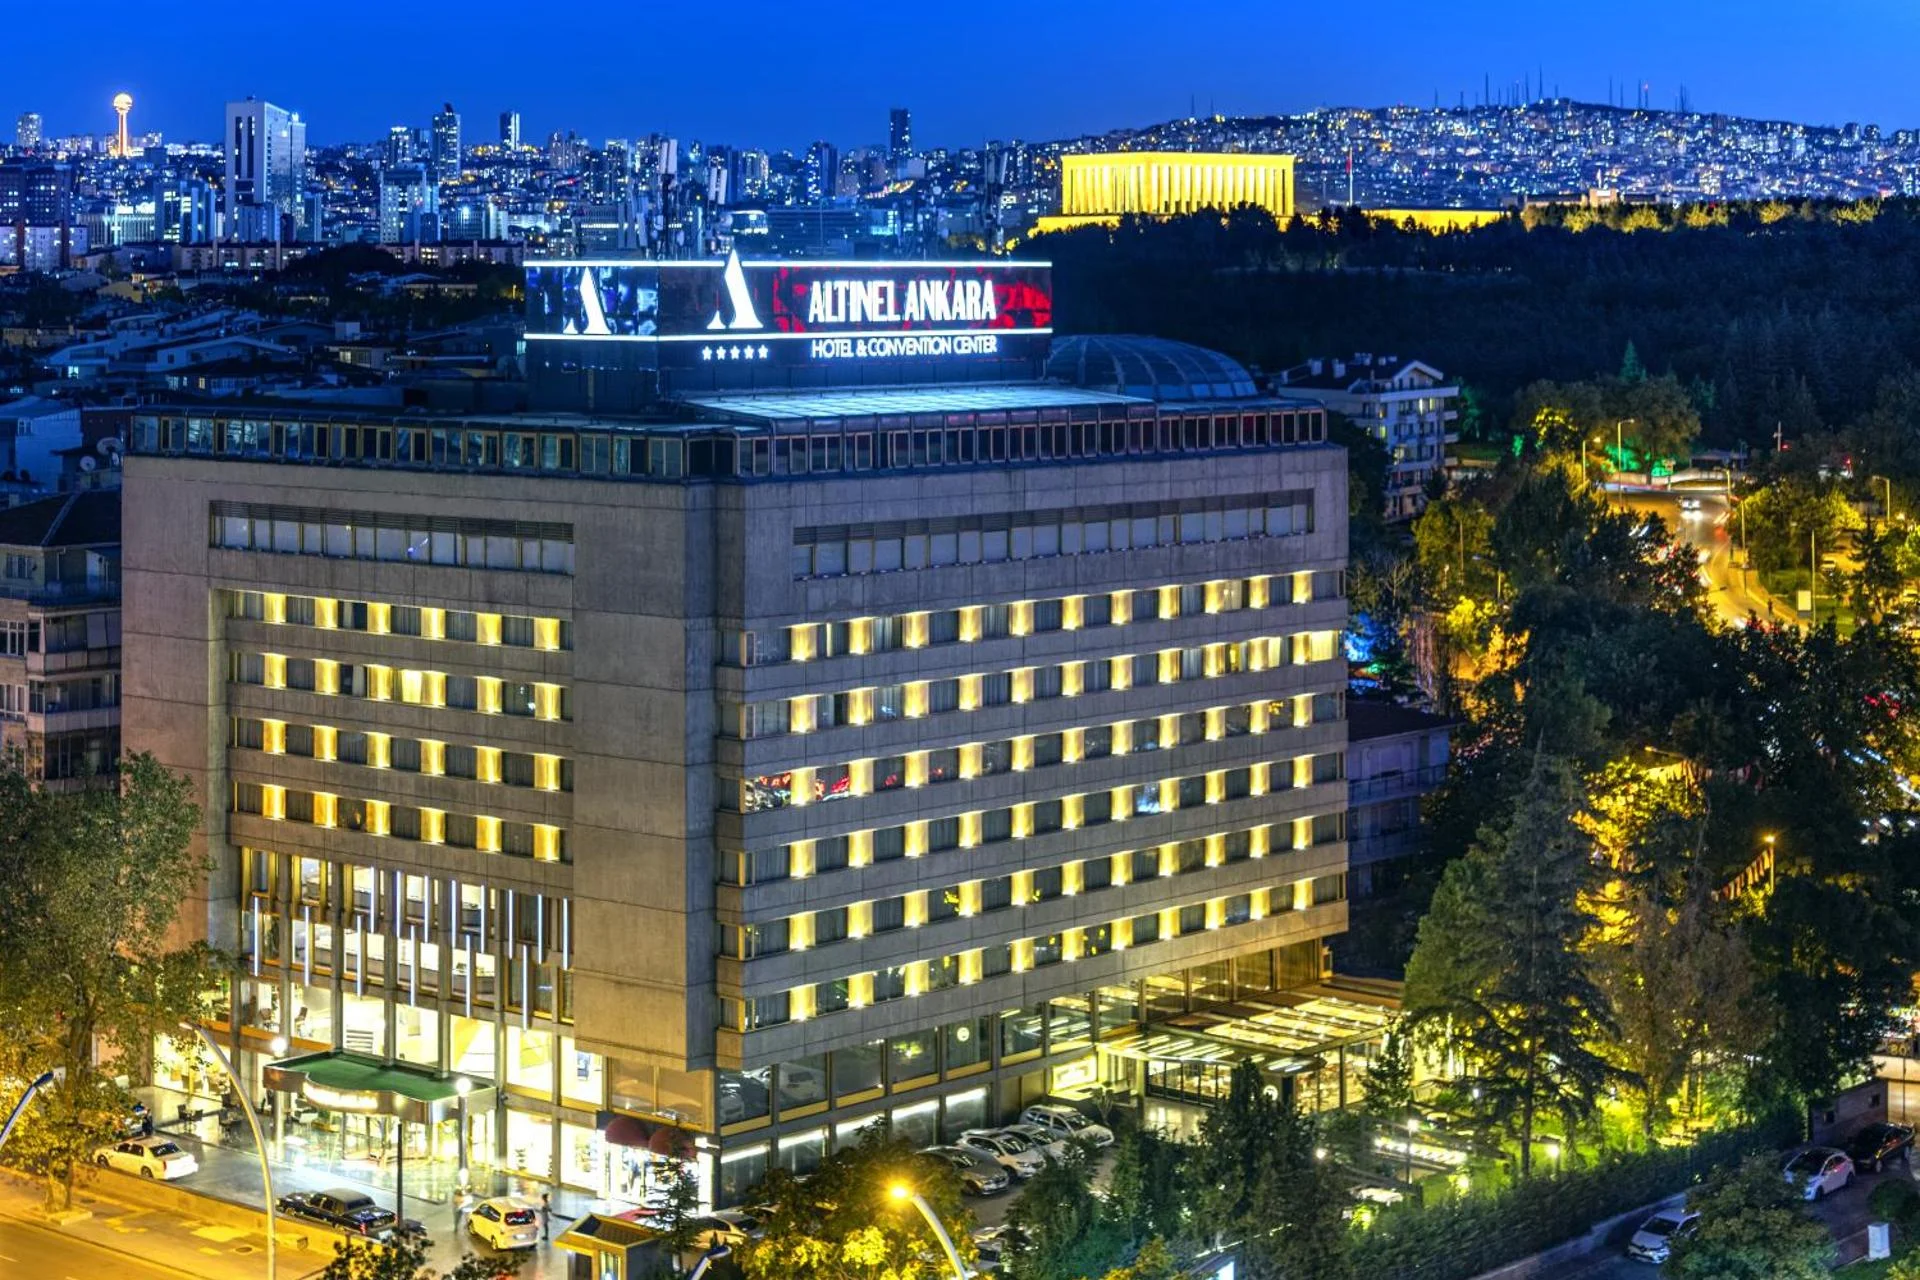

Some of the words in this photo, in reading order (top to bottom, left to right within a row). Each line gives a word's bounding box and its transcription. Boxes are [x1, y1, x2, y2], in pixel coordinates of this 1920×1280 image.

[808, 280, 901, 323] ALTINEL
[904, 279, 997, 321] ANKARA
[811, 338, 854, 358] HOTEL
[868, 335, 952, 357] CONVENTION
[953, 334, 998, 355] CENTER
